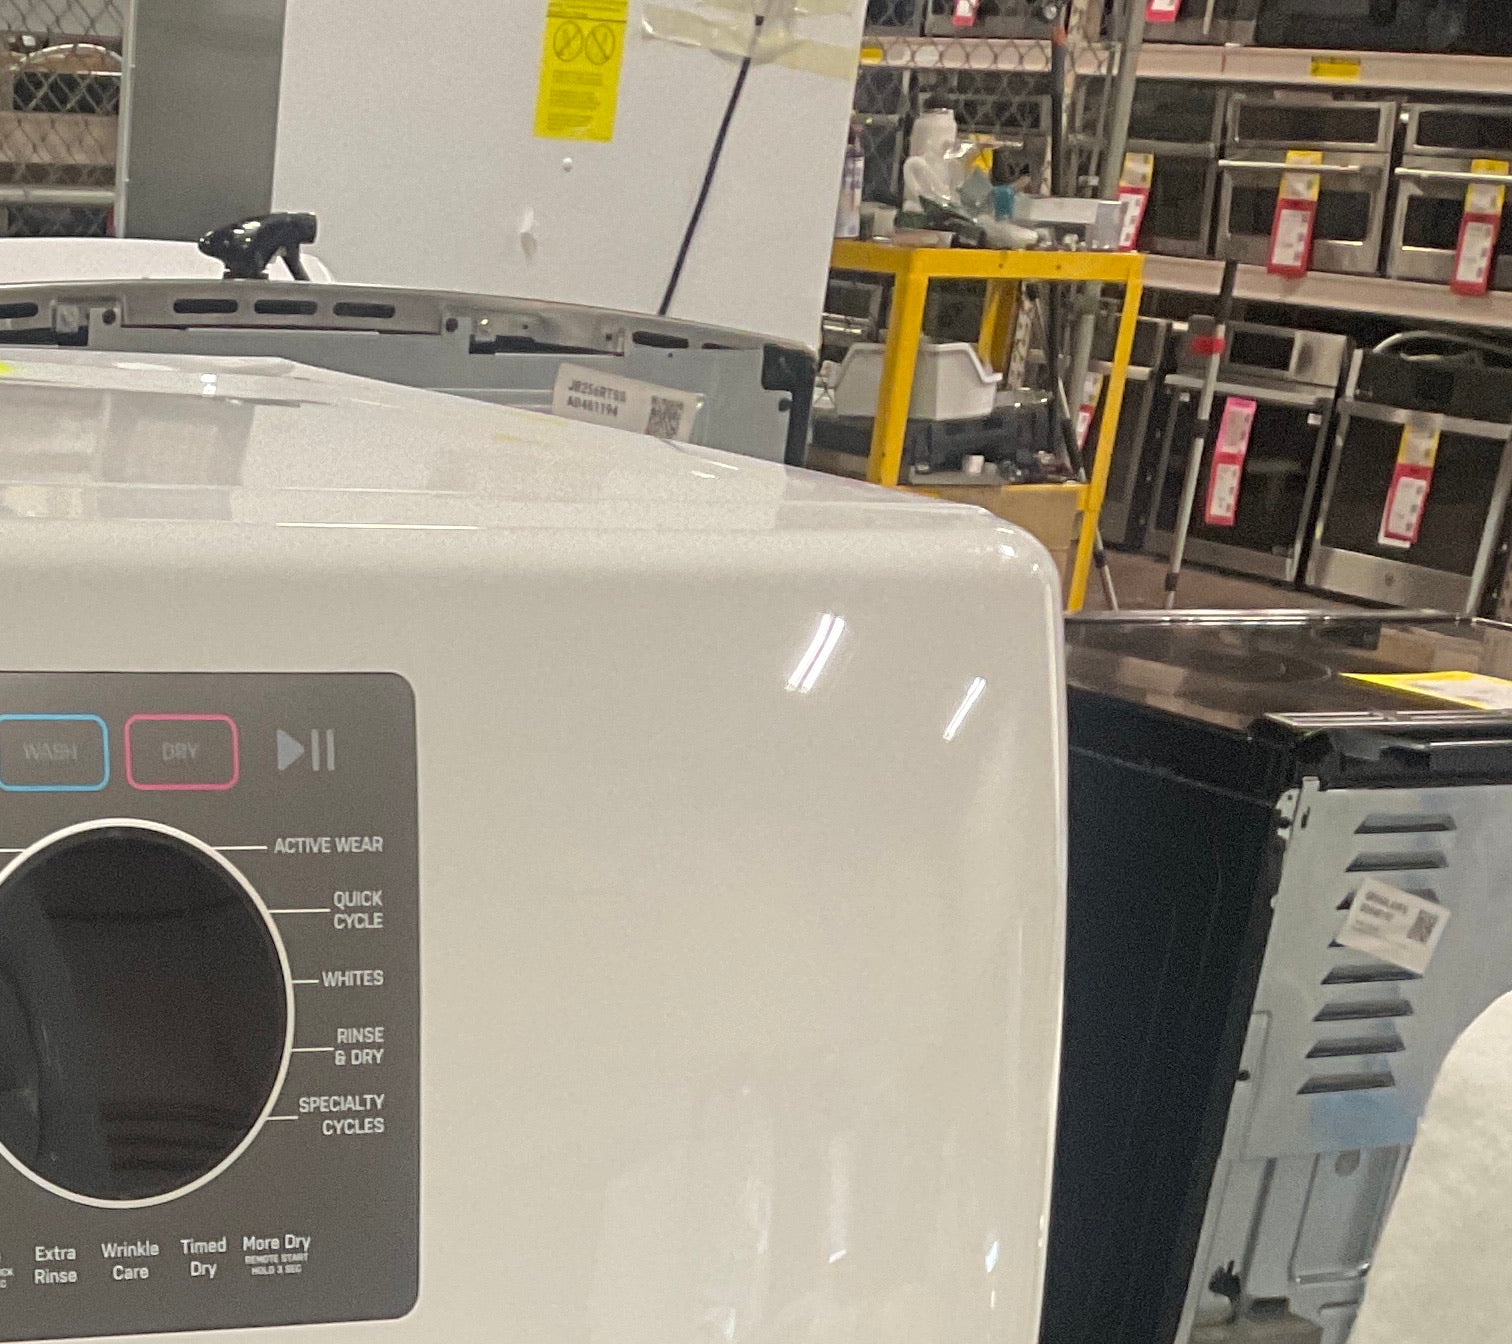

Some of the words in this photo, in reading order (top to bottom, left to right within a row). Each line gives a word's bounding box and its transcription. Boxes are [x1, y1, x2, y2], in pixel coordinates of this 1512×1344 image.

[22, 741, 79, 761] WASH
[161, 741, 201, 761] DRY
[273, 837, 331, 853] ACTIVE
[335, 836, 384, 852] WEAR
[333, 890, 383, 910] QUICK
[333, 912, 384, 930] CYCLE
[322, 969, 385, 987] WHITES
[336, 1026, 385, 1044] RINSE
[334, 1050, 347, 1066] &
[350, 1048, 385, 1065] DRY
[298, 1093, 385, 1113] SPECIALTY
[322, 1117, 385, 1136] CYCLES
[101, 1240, 161, 1259] Wrinkle
[180, 1236, 228, 1255] Timed
[243, 1235, 281, 1251] More
[284, 1233, 312, 1252] Dry
[34, 1245, 77, 1262] Extra
[34, 1268, 79, 1285] Rinse
[112, 1264, 150, 1282] Care
[190, 1261, 218, 1280] Dry
